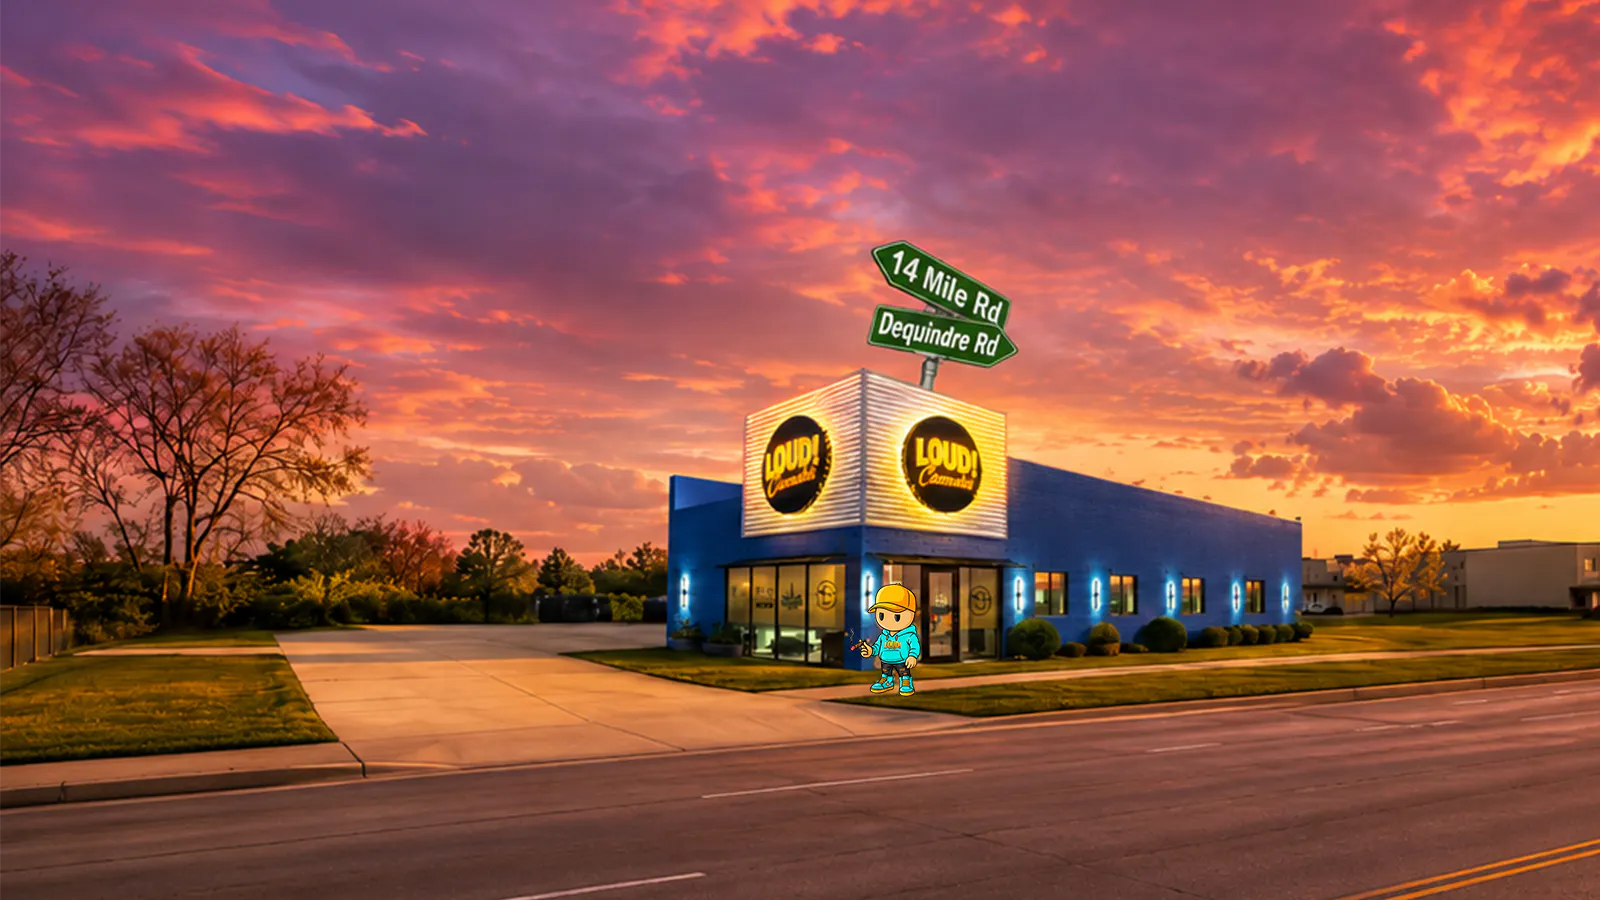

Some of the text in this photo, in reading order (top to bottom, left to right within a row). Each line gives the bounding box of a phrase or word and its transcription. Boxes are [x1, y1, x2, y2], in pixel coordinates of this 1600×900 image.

[892, 250, 1003, 324] 14 Mile Rd
[878, 311, 1001, 356] Dequindre Rd
[765, 433, 820, 482] LOUD!
[915, 436, 978, 479] LOUD!
